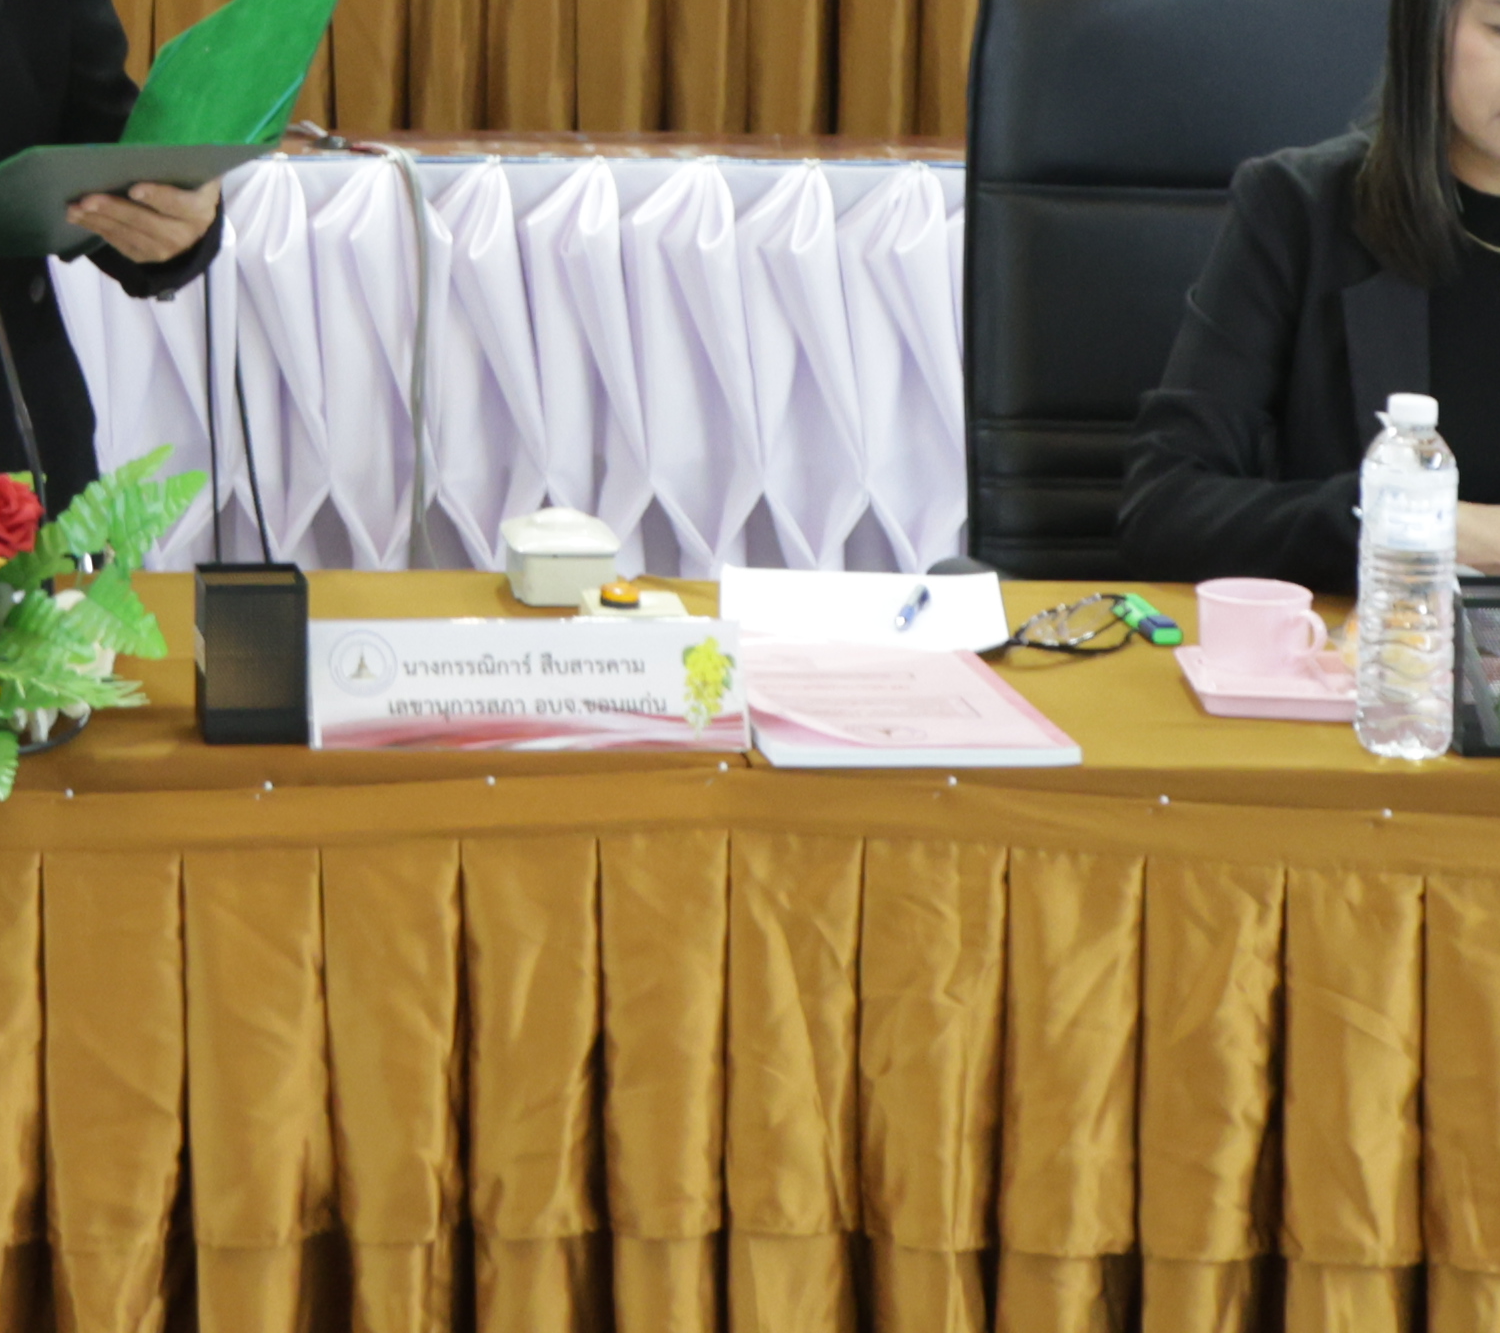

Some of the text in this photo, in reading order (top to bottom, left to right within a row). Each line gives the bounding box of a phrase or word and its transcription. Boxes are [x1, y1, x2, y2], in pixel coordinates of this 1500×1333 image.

[402, 652, 531, 677] นางกรรณิการ์
[387, 695, 527, 720] เลขานุการสภา
